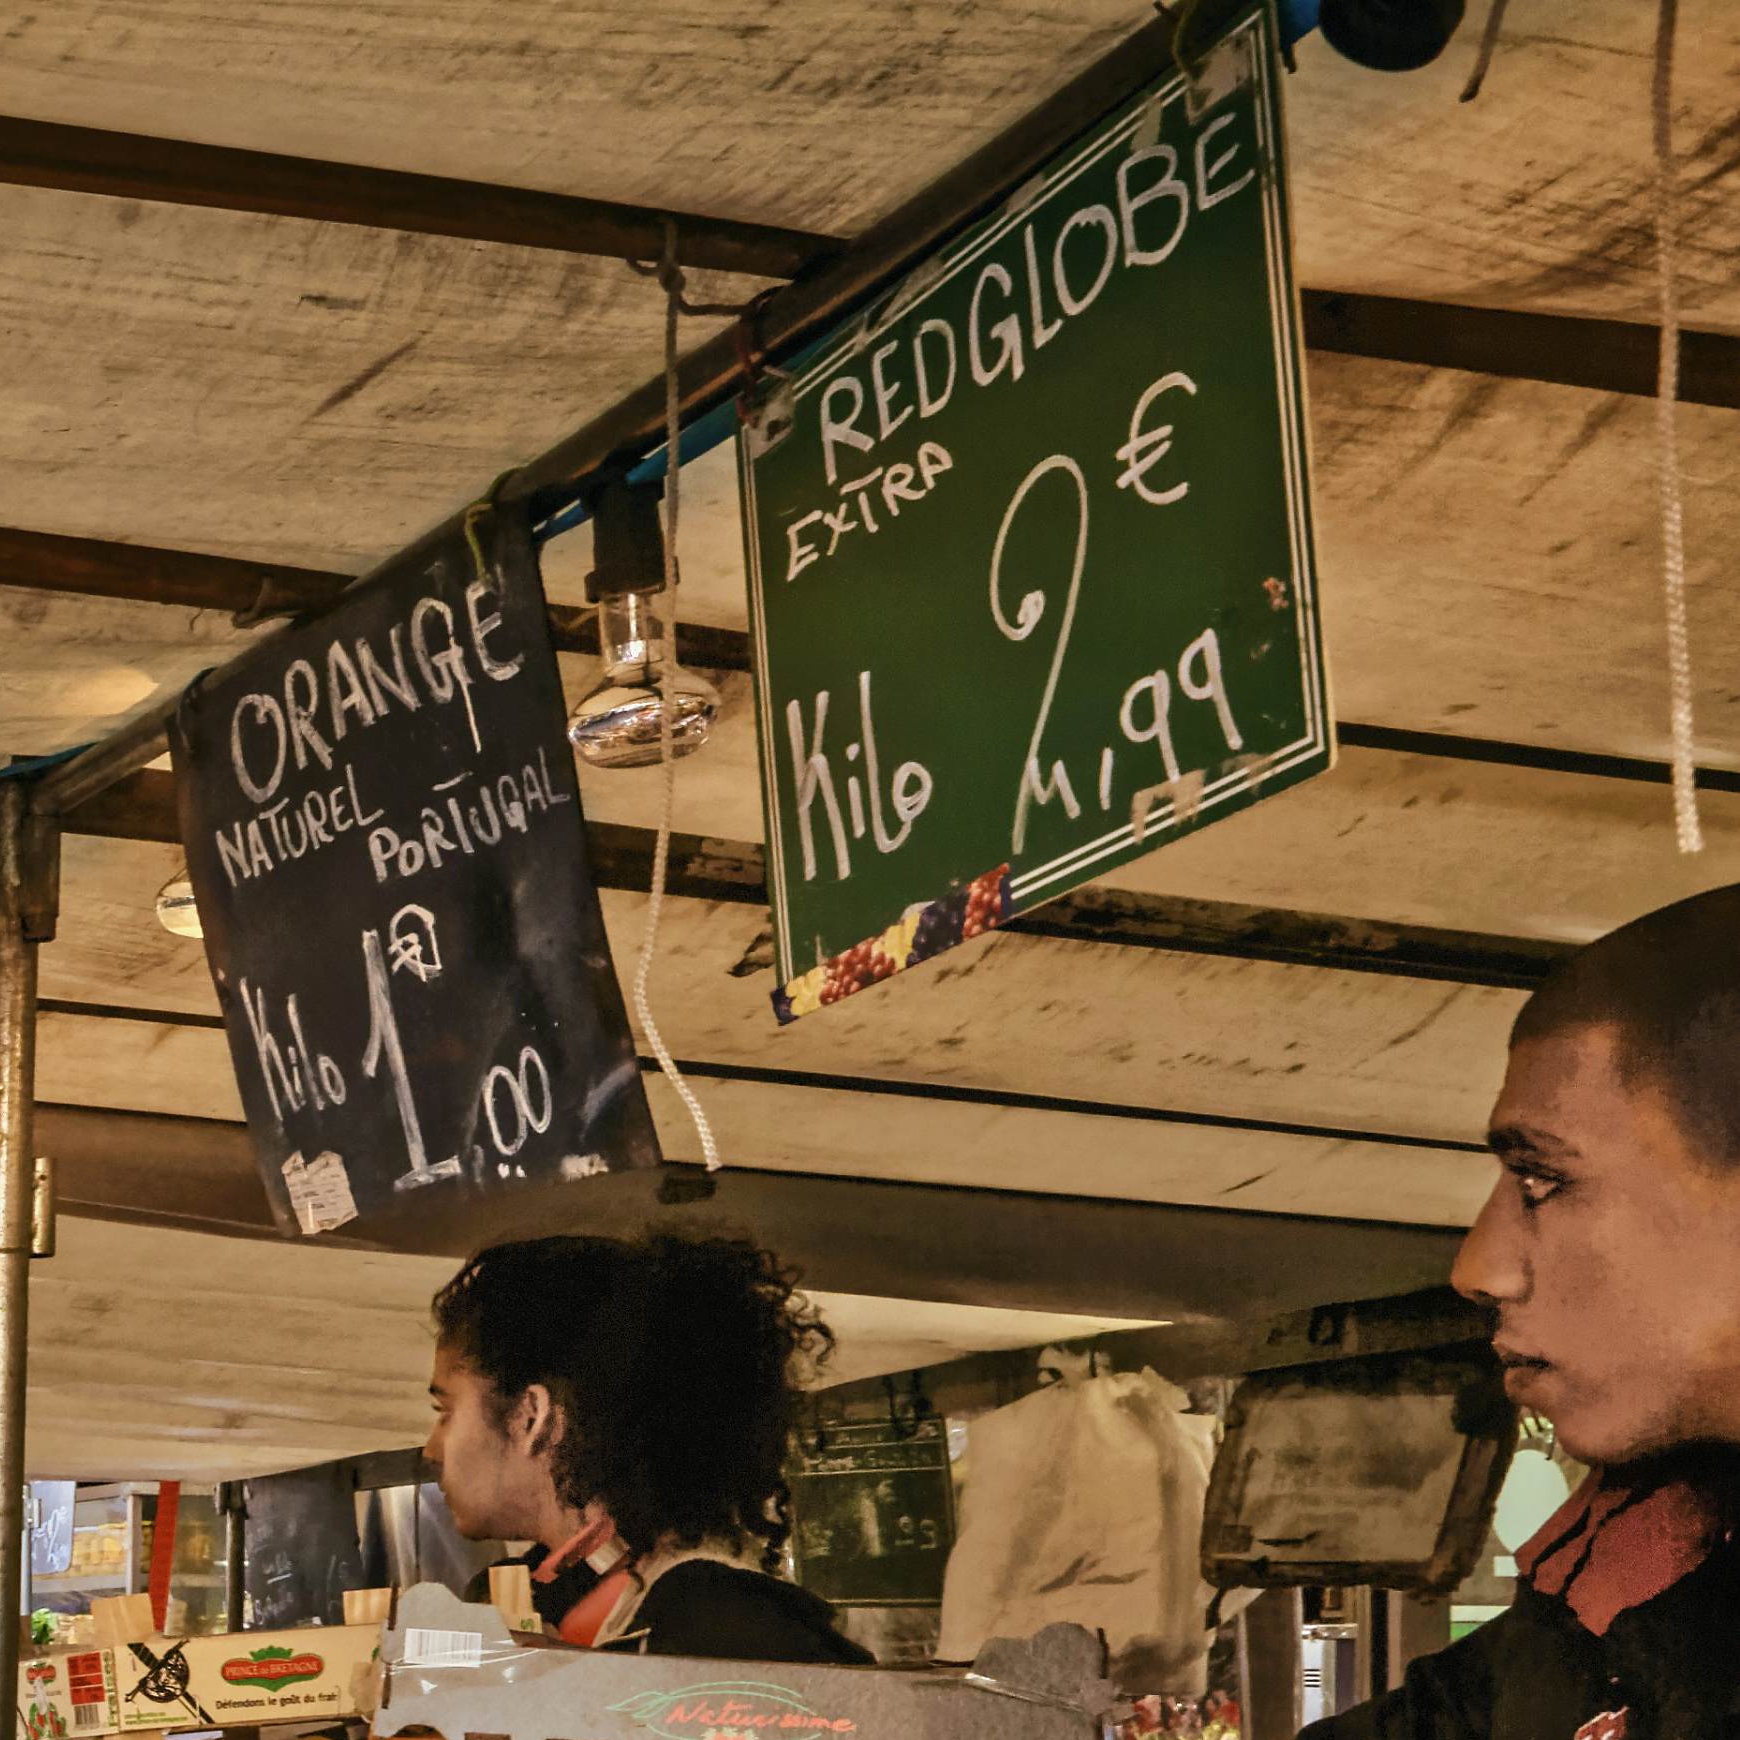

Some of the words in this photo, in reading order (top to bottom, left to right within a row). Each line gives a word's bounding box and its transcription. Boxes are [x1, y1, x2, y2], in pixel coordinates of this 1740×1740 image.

[1115, 371, 1197, 506] €
[785, 441, 955, 582] EXTRA
[230, 577, 525, 804] ORANGE
[215, 763, 386, 888] NATUREL
[367, 746, 572, 884] PORTUGAL
[238, 976, 347, 1122] Kilo
